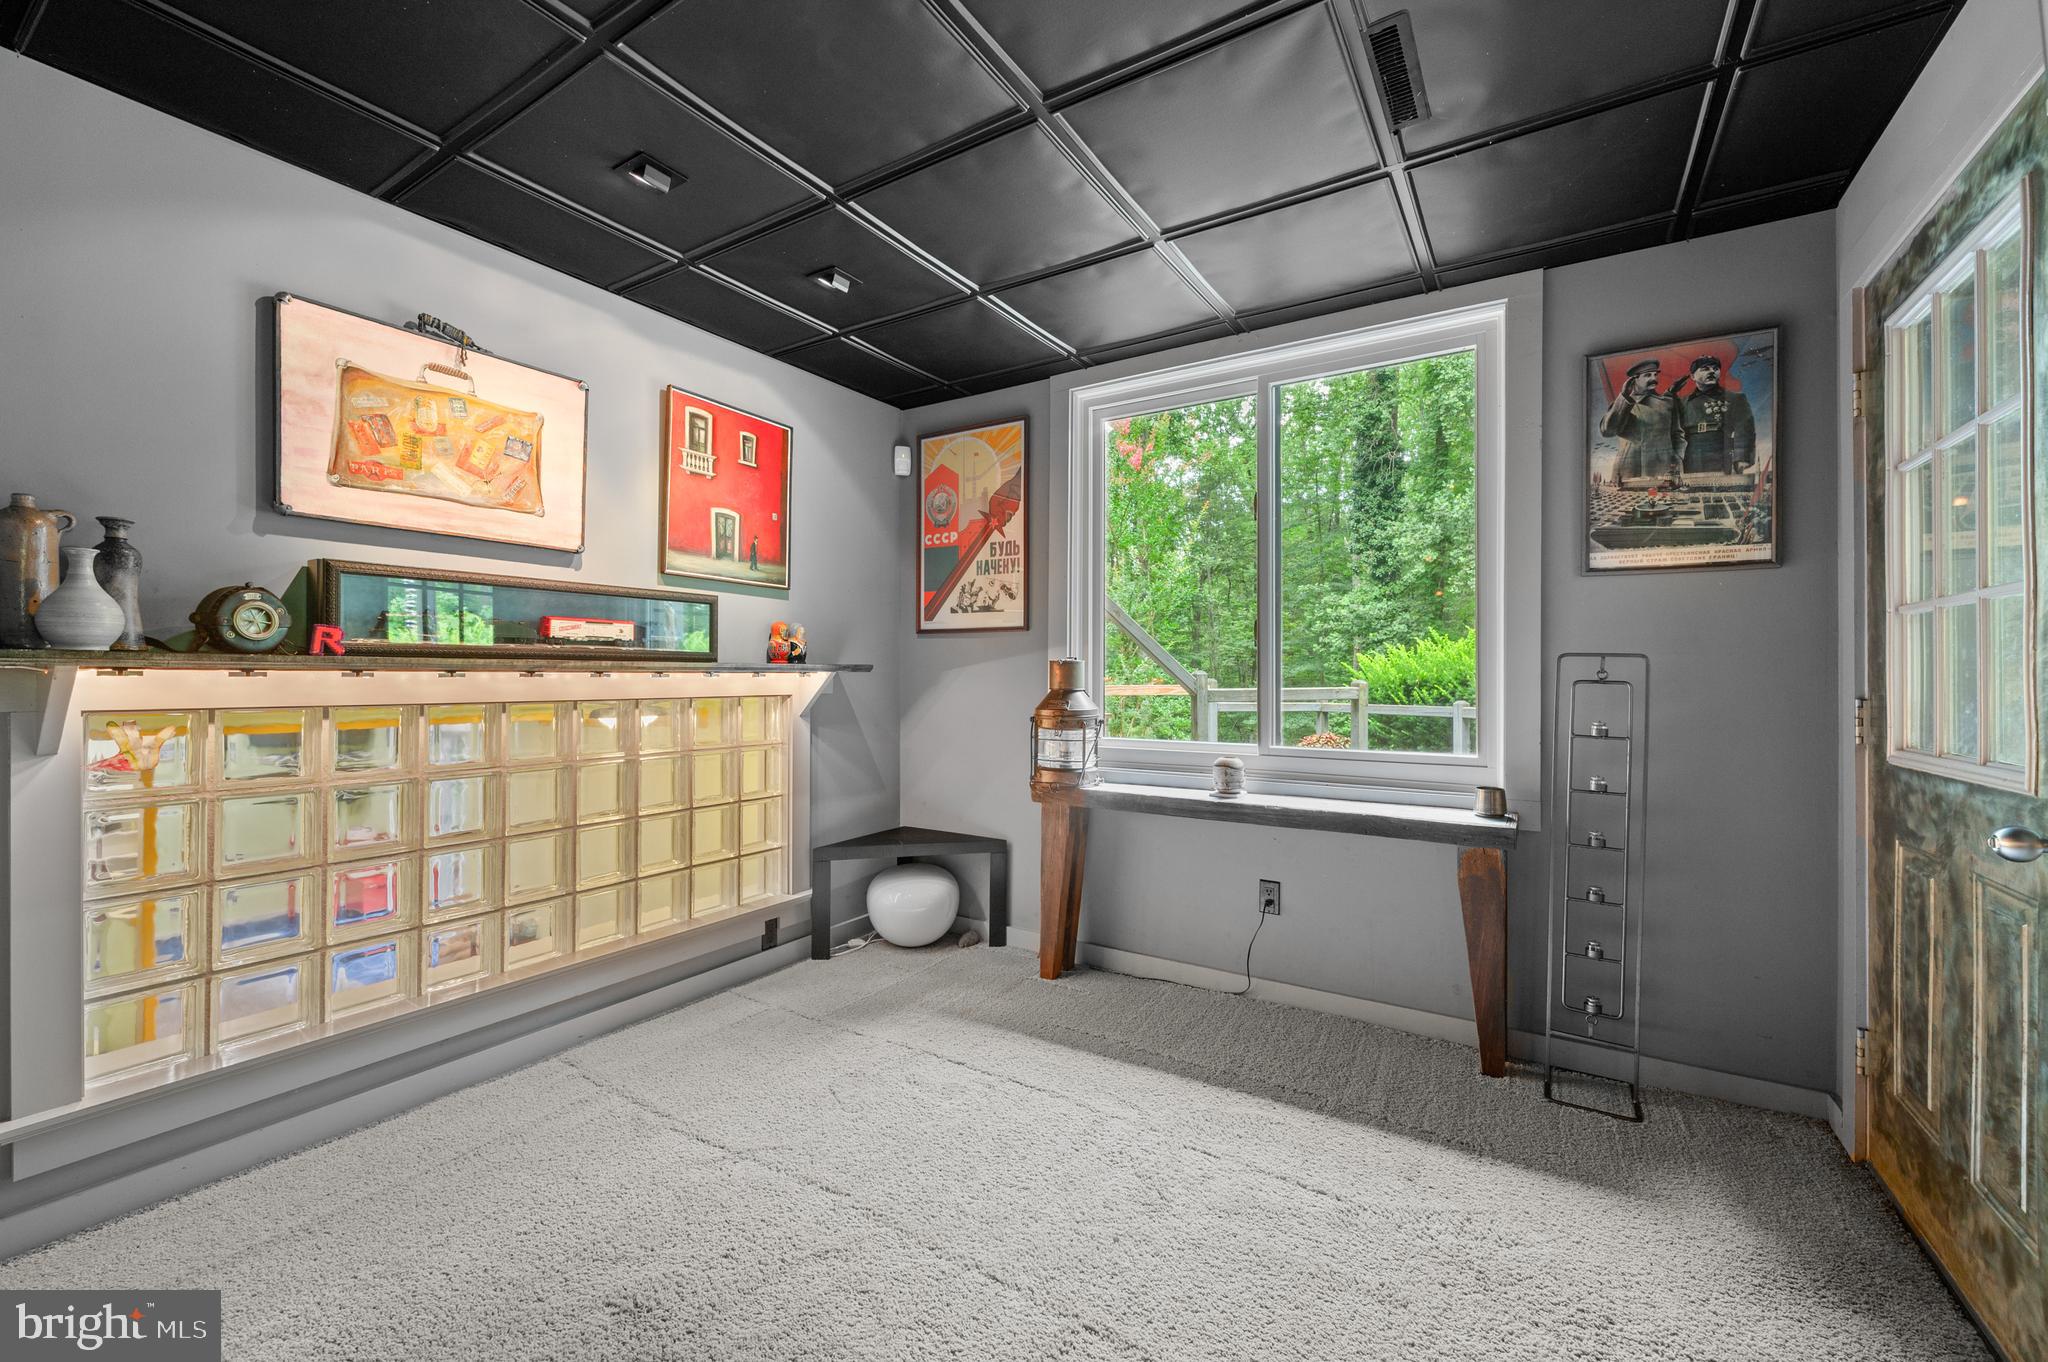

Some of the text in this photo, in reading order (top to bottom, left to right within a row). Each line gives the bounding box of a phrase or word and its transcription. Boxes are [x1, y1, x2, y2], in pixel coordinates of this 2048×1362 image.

[925, 532, 958, 545] СССР
[990, 540, 1020, 557] БУДЬ
[309, 624, 346, 655] R
